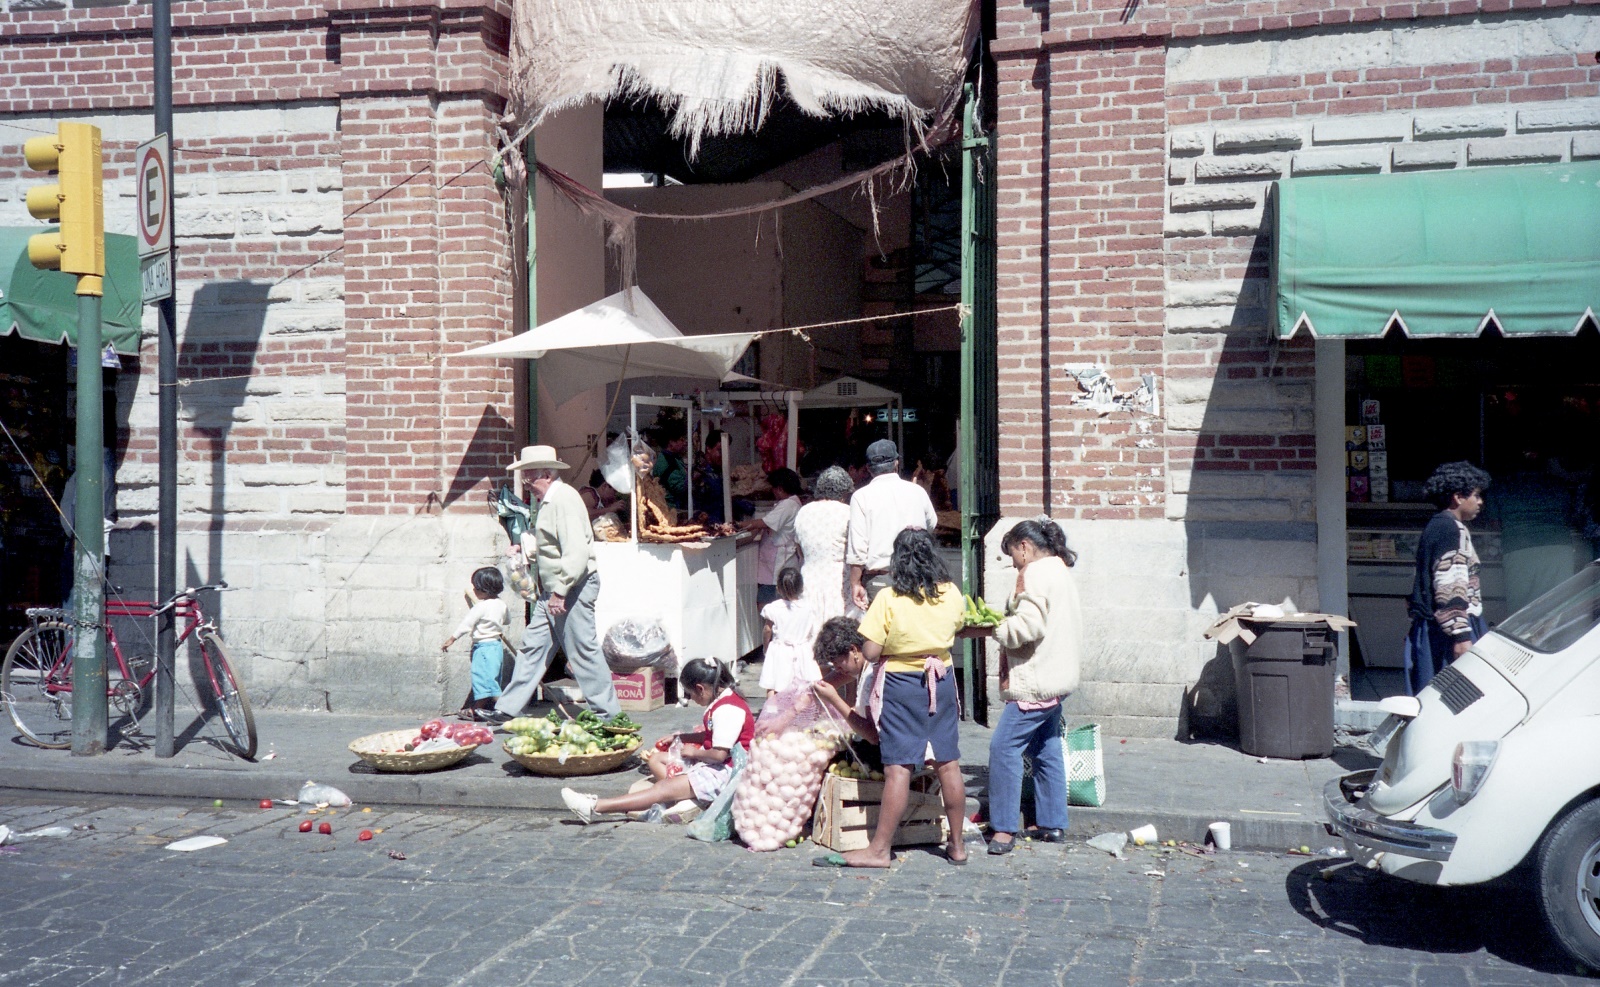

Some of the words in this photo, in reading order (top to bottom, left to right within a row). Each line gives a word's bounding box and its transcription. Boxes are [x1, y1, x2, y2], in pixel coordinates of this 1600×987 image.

[145, 166, 160, 228] E
[144, 266, 155, 294] UNA
[156, 260, 169, 289] HORA
[616, 688, 644, 698] RONA
